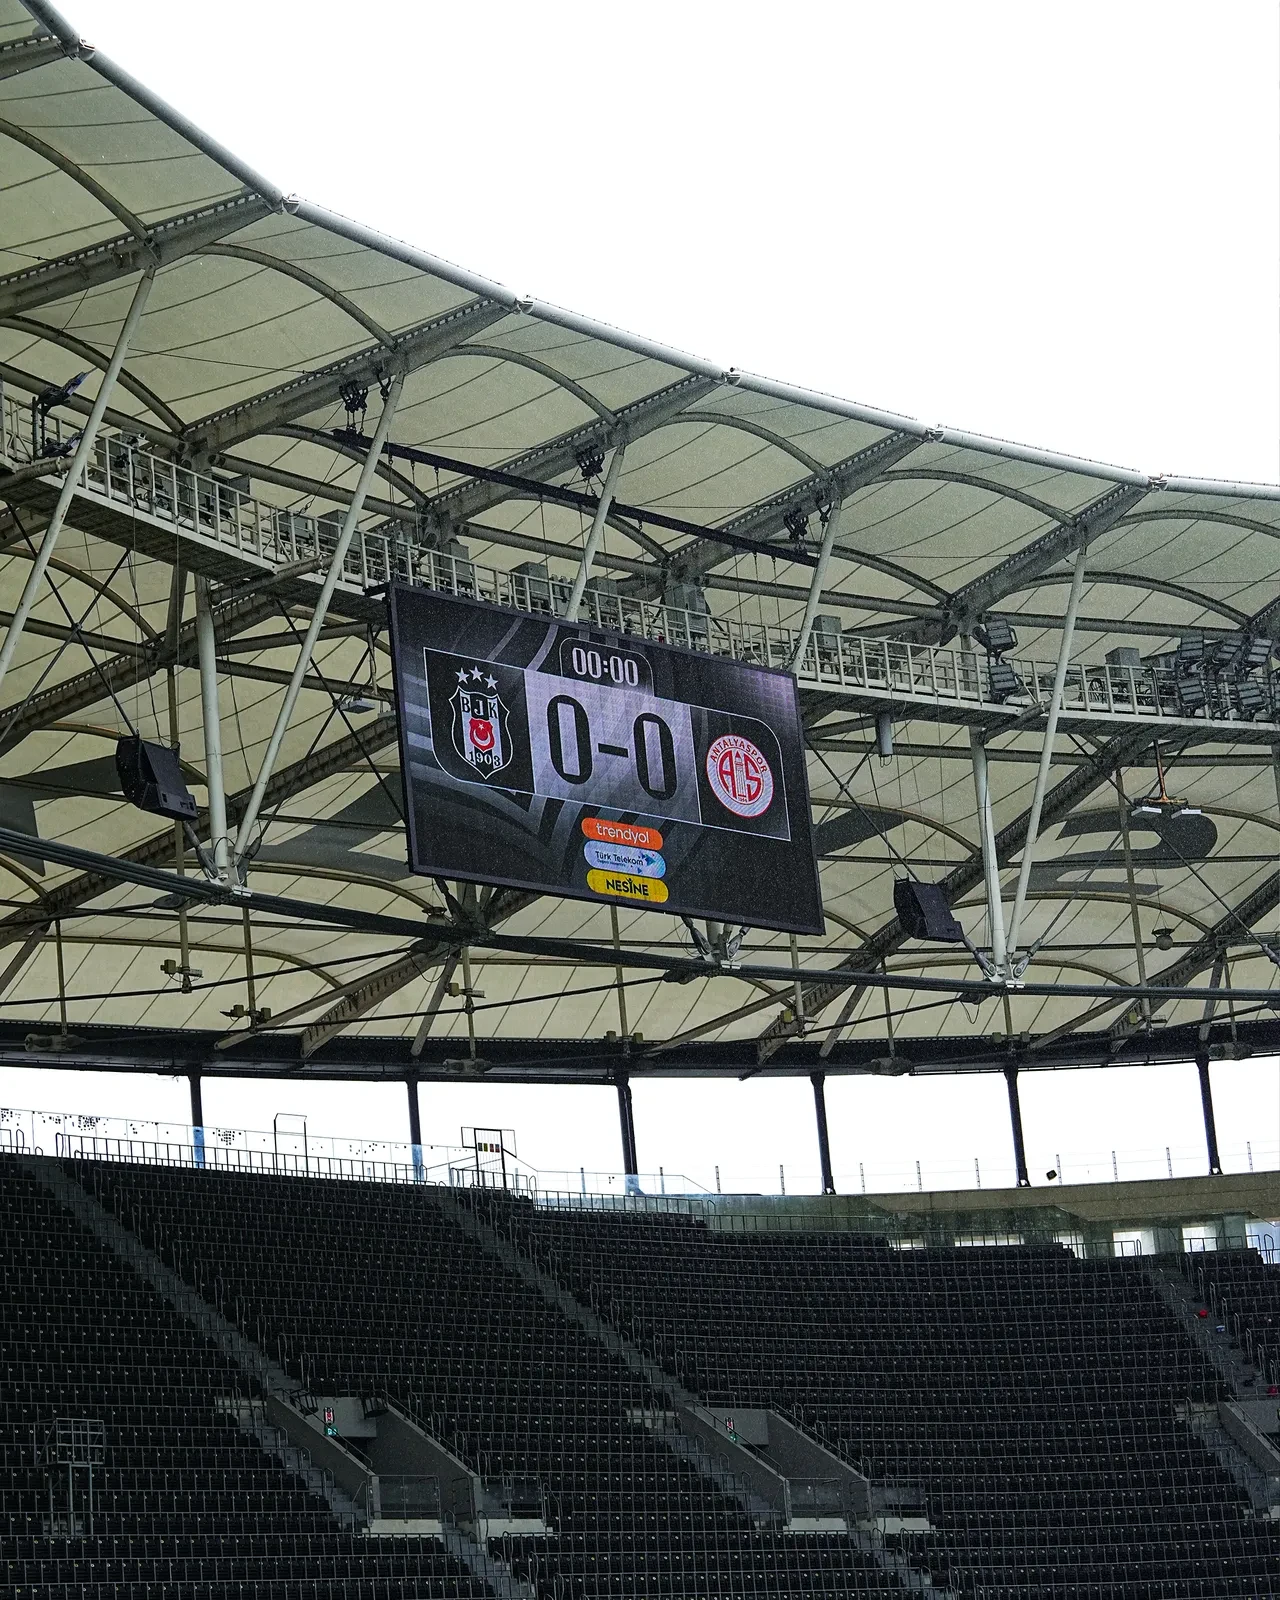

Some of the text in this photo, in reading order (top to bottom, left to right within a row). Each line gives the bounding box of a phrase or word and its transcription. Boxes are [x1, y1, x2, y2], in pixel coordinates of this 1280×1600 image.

[571, 647, 639, 686] 00:00
[461, 696, 497, 719] BJK
[468, 751, 501, 766] 1903
[709, 738, 768, 773] ANTALYASPOR
[596, 823, 649, 843] trendyol
[595, 850, 611, 861] Türk
[612, 853, 644, 866] Telekom
